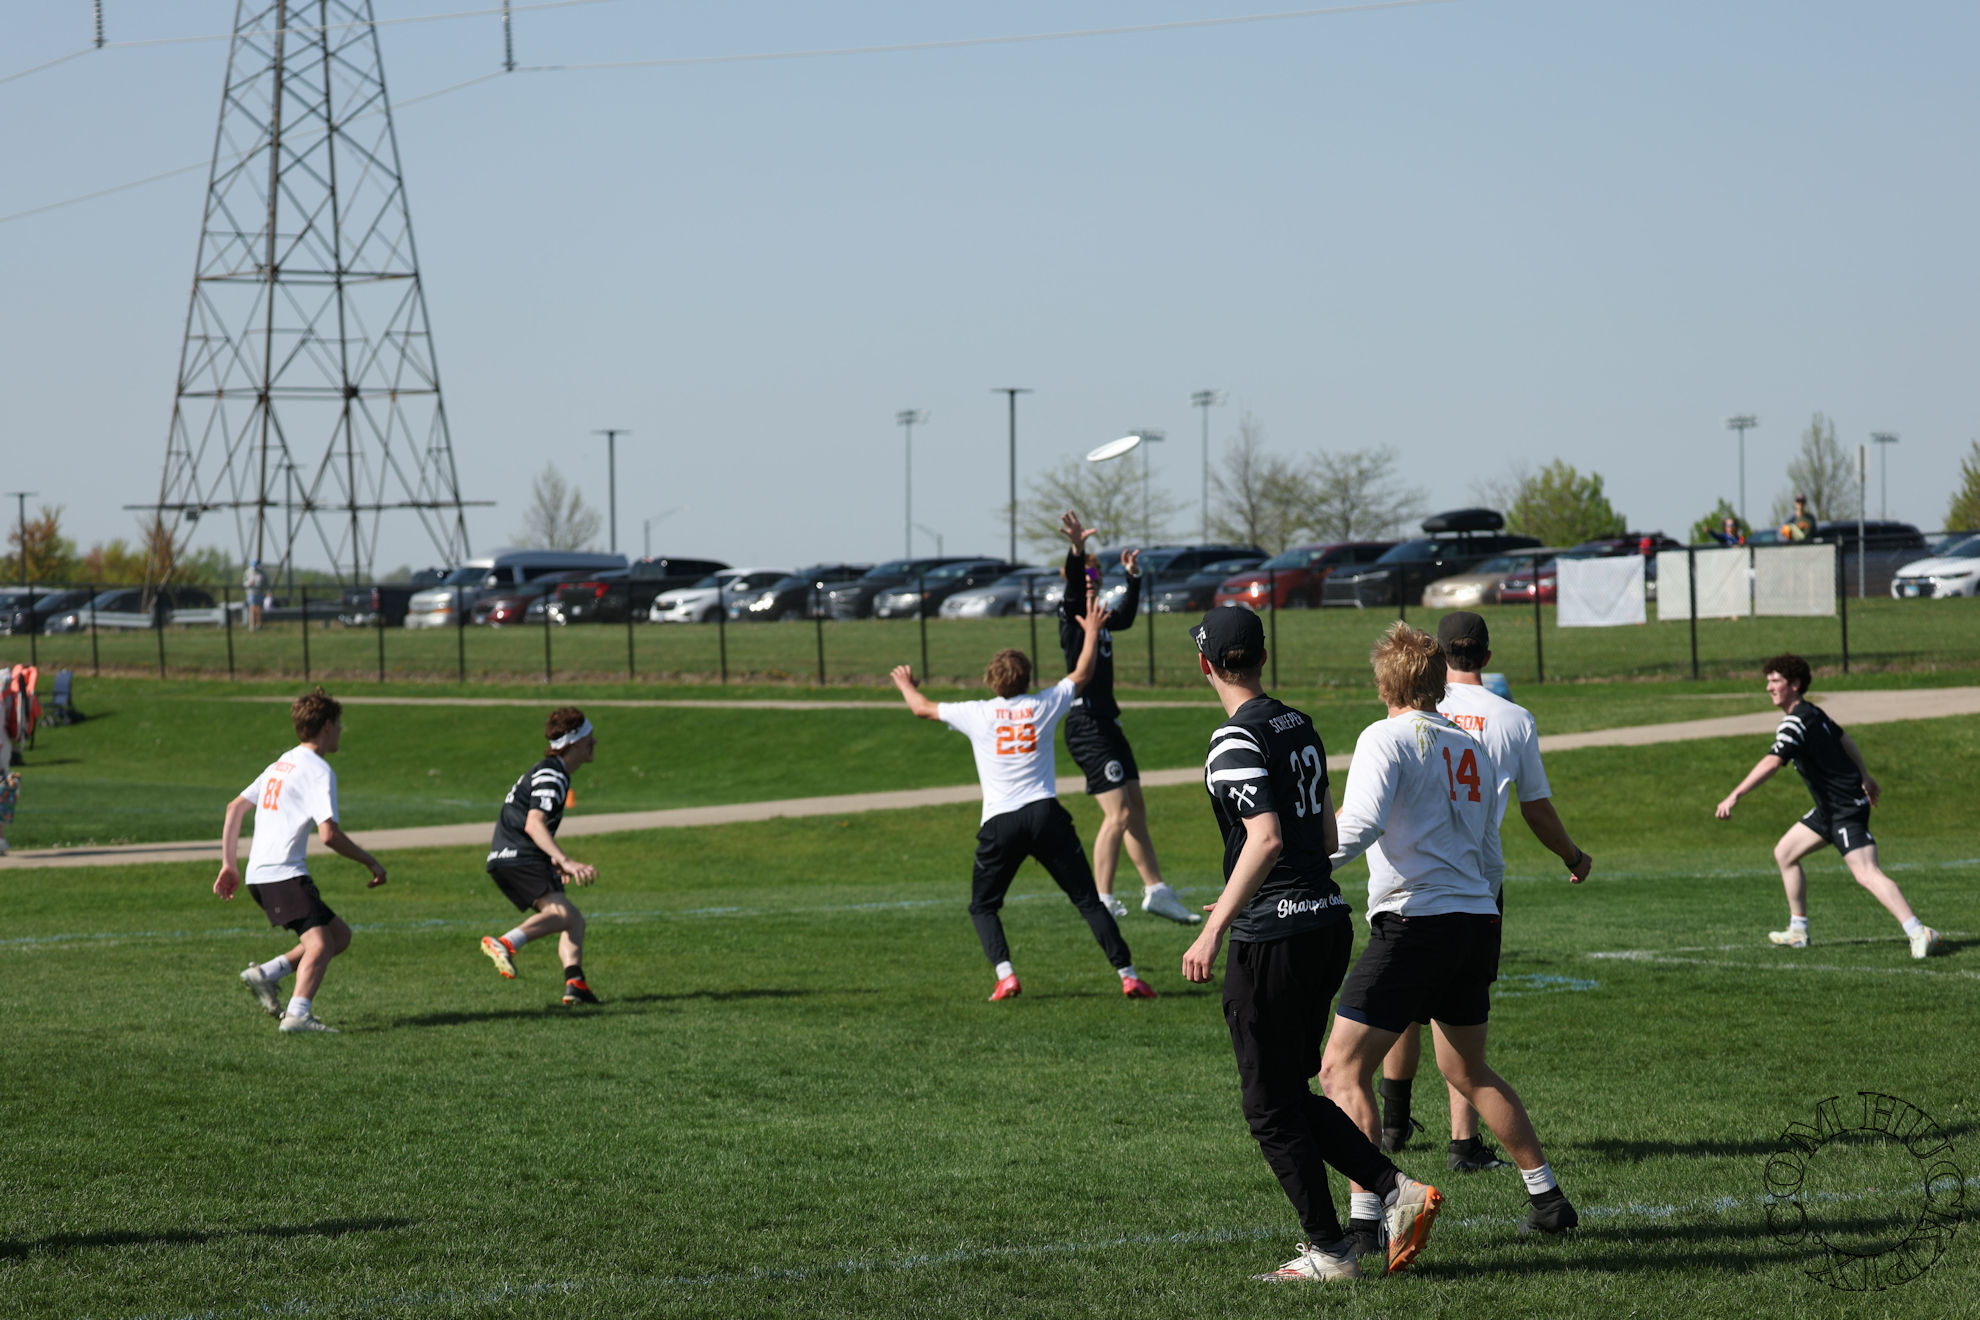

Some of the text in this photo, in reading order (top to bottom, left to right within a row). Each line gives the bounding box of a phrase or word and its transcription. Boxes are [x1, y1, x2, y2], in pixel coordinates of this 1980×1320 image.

[996, 723, 1037, 755] 29
[263, 777, 283, 811] 81
[1290, 745, 1322, 818] 32
[1442, 746, 1481, 803] 14
